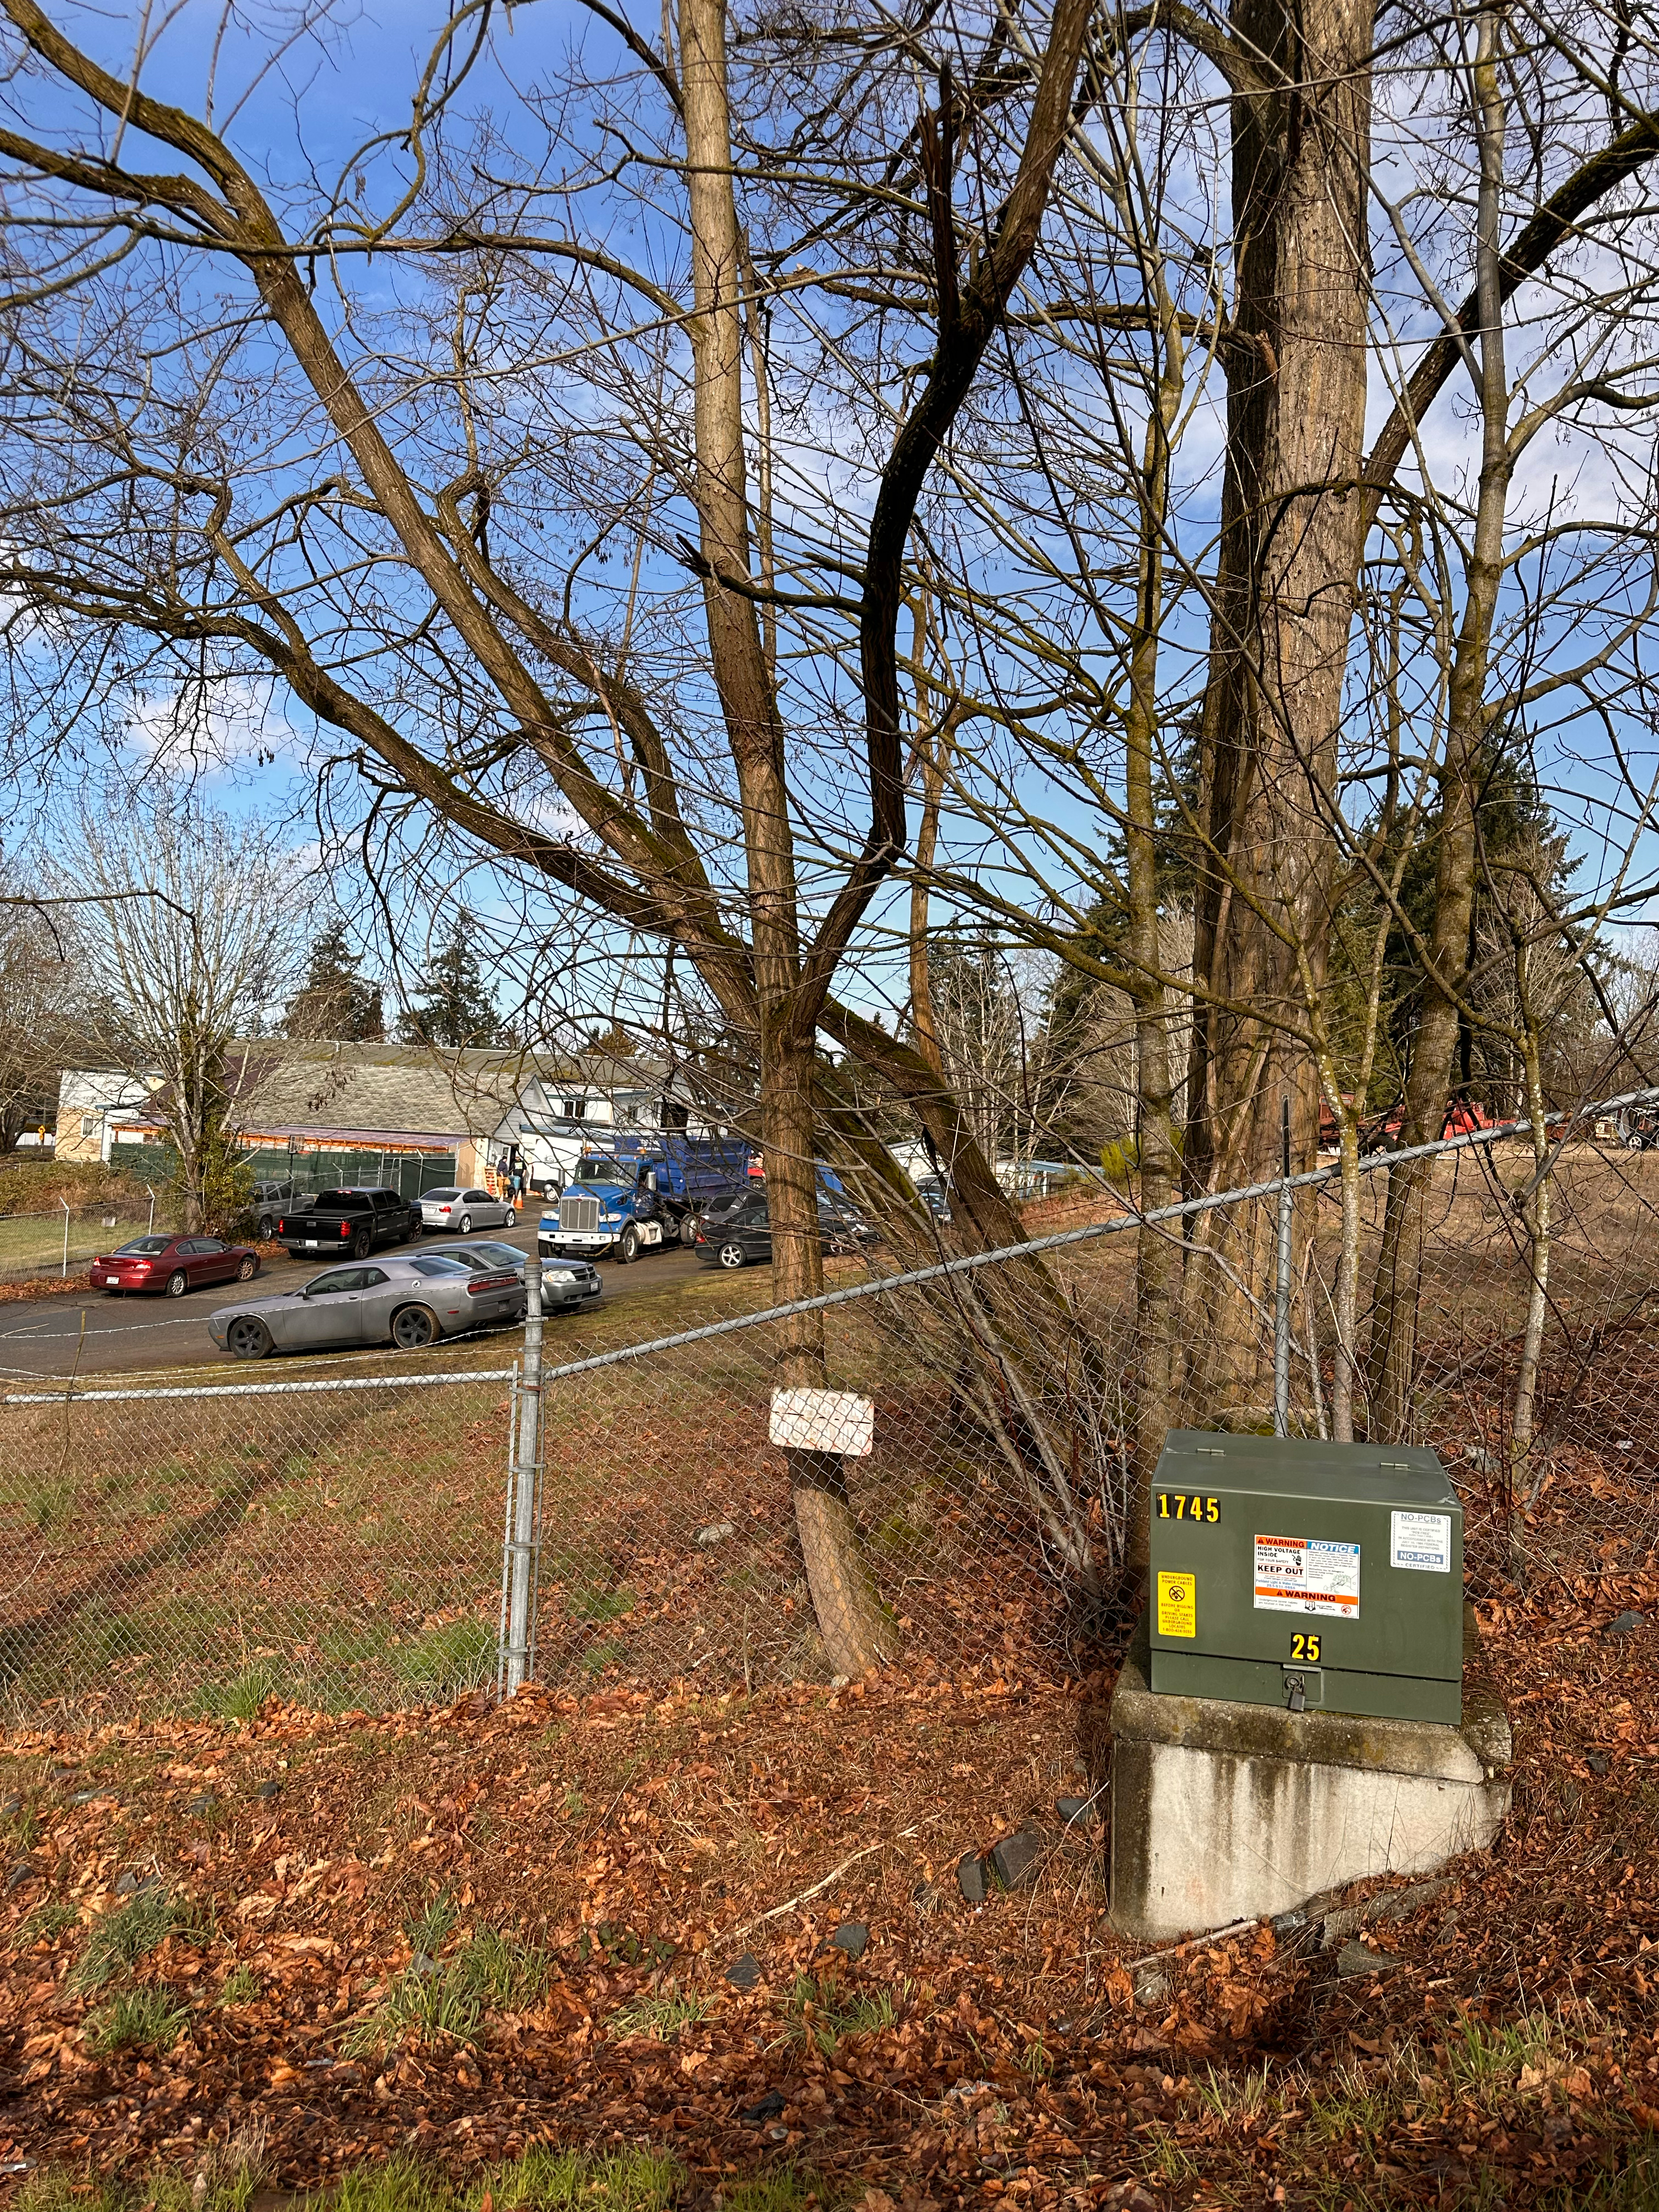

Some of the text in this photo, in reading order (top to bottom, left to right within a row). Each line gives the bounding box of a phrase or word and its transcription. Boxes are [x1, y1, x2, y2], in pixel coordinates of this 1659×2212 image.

[1159, 1494, 1218, 1522] 1745
[1401, 1513, 1441, 1523] NO-PCBs
[1266, 1538, 1305, 1548] WARNING
[1311, 1542, 1356, 1554] NOTICE
[1400, 1551, 1441, 1563] NO-PCBs
[1257, 1565, 1282, 1573] KEEP
[1285, 1567, 1304, 1576] OUT
[1285, 1590, 1336, 1602] WARNING
[1291, 1634, 1319, 1661] 25
